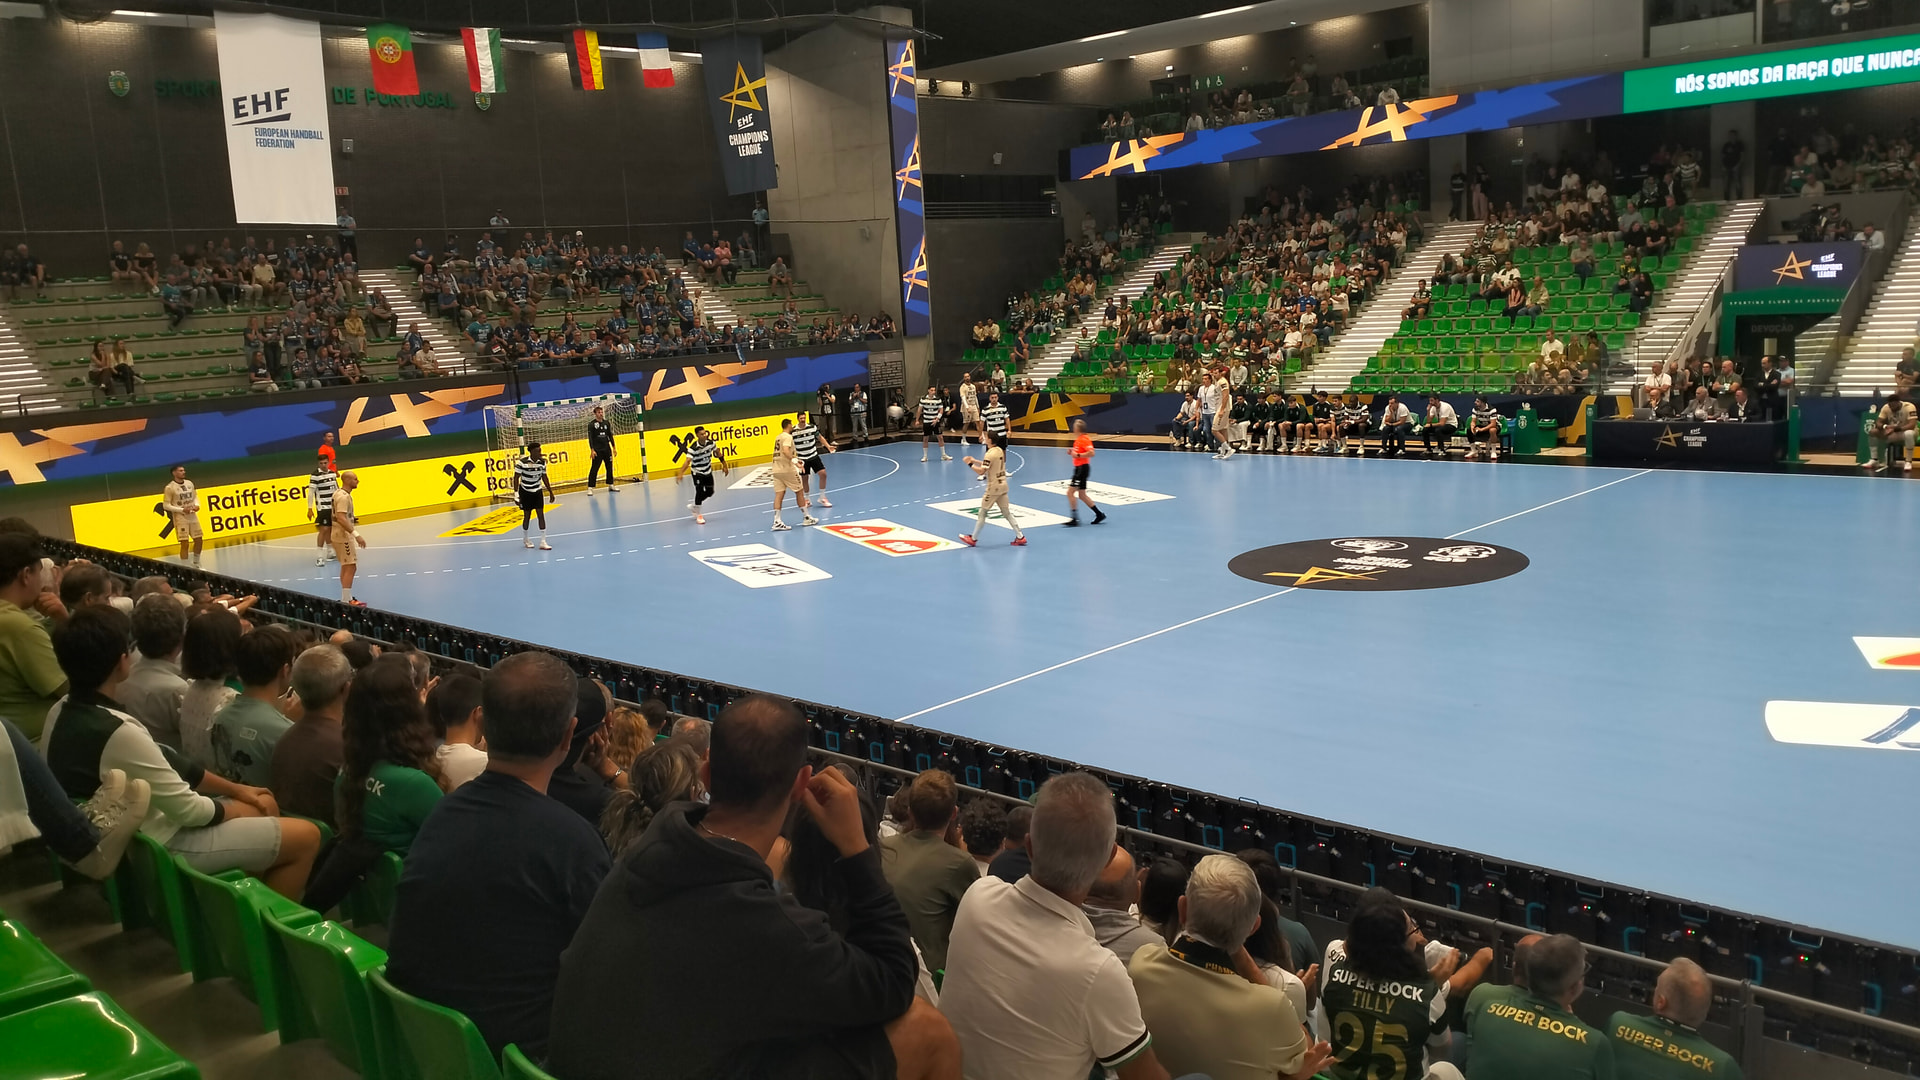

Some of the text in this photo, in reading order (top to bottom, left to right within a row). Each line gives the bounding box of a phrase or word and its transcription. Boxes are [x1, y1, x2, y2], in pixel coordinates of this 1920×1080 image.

[1675, 48, 1920, 94] NÓS SOMOS DA RAÇA QUE NUNCA
[154, 79, 219, 98] SPORT
[332, 86, 356, 104] DE
[232, 87, 290, 119] EHF
[737, 113, 753, 128] EHF
[254, 127, 324, 141] EUROPEAN HANDBALL
[255, 138, 295, 149] FEDERATION
[728, 130, 769, 146] CHAMPIONS
[738, 143, 762, 157] LEAGUE
[712, 443, 737, 458] ank
[210, 511, 265, 532] Bank
[365, 777, 386, 796] CK
[1332, 969, 1424, 1002] SUPER BOCK
[1352, 989, 1396, 1015] TILLY
[1487, 1003, 1588, 1044] SUPER BOCK
[1329, 1011, 1409, 1080] 25
[1615, 1025, 1715, 1073] SUPER BOCK
